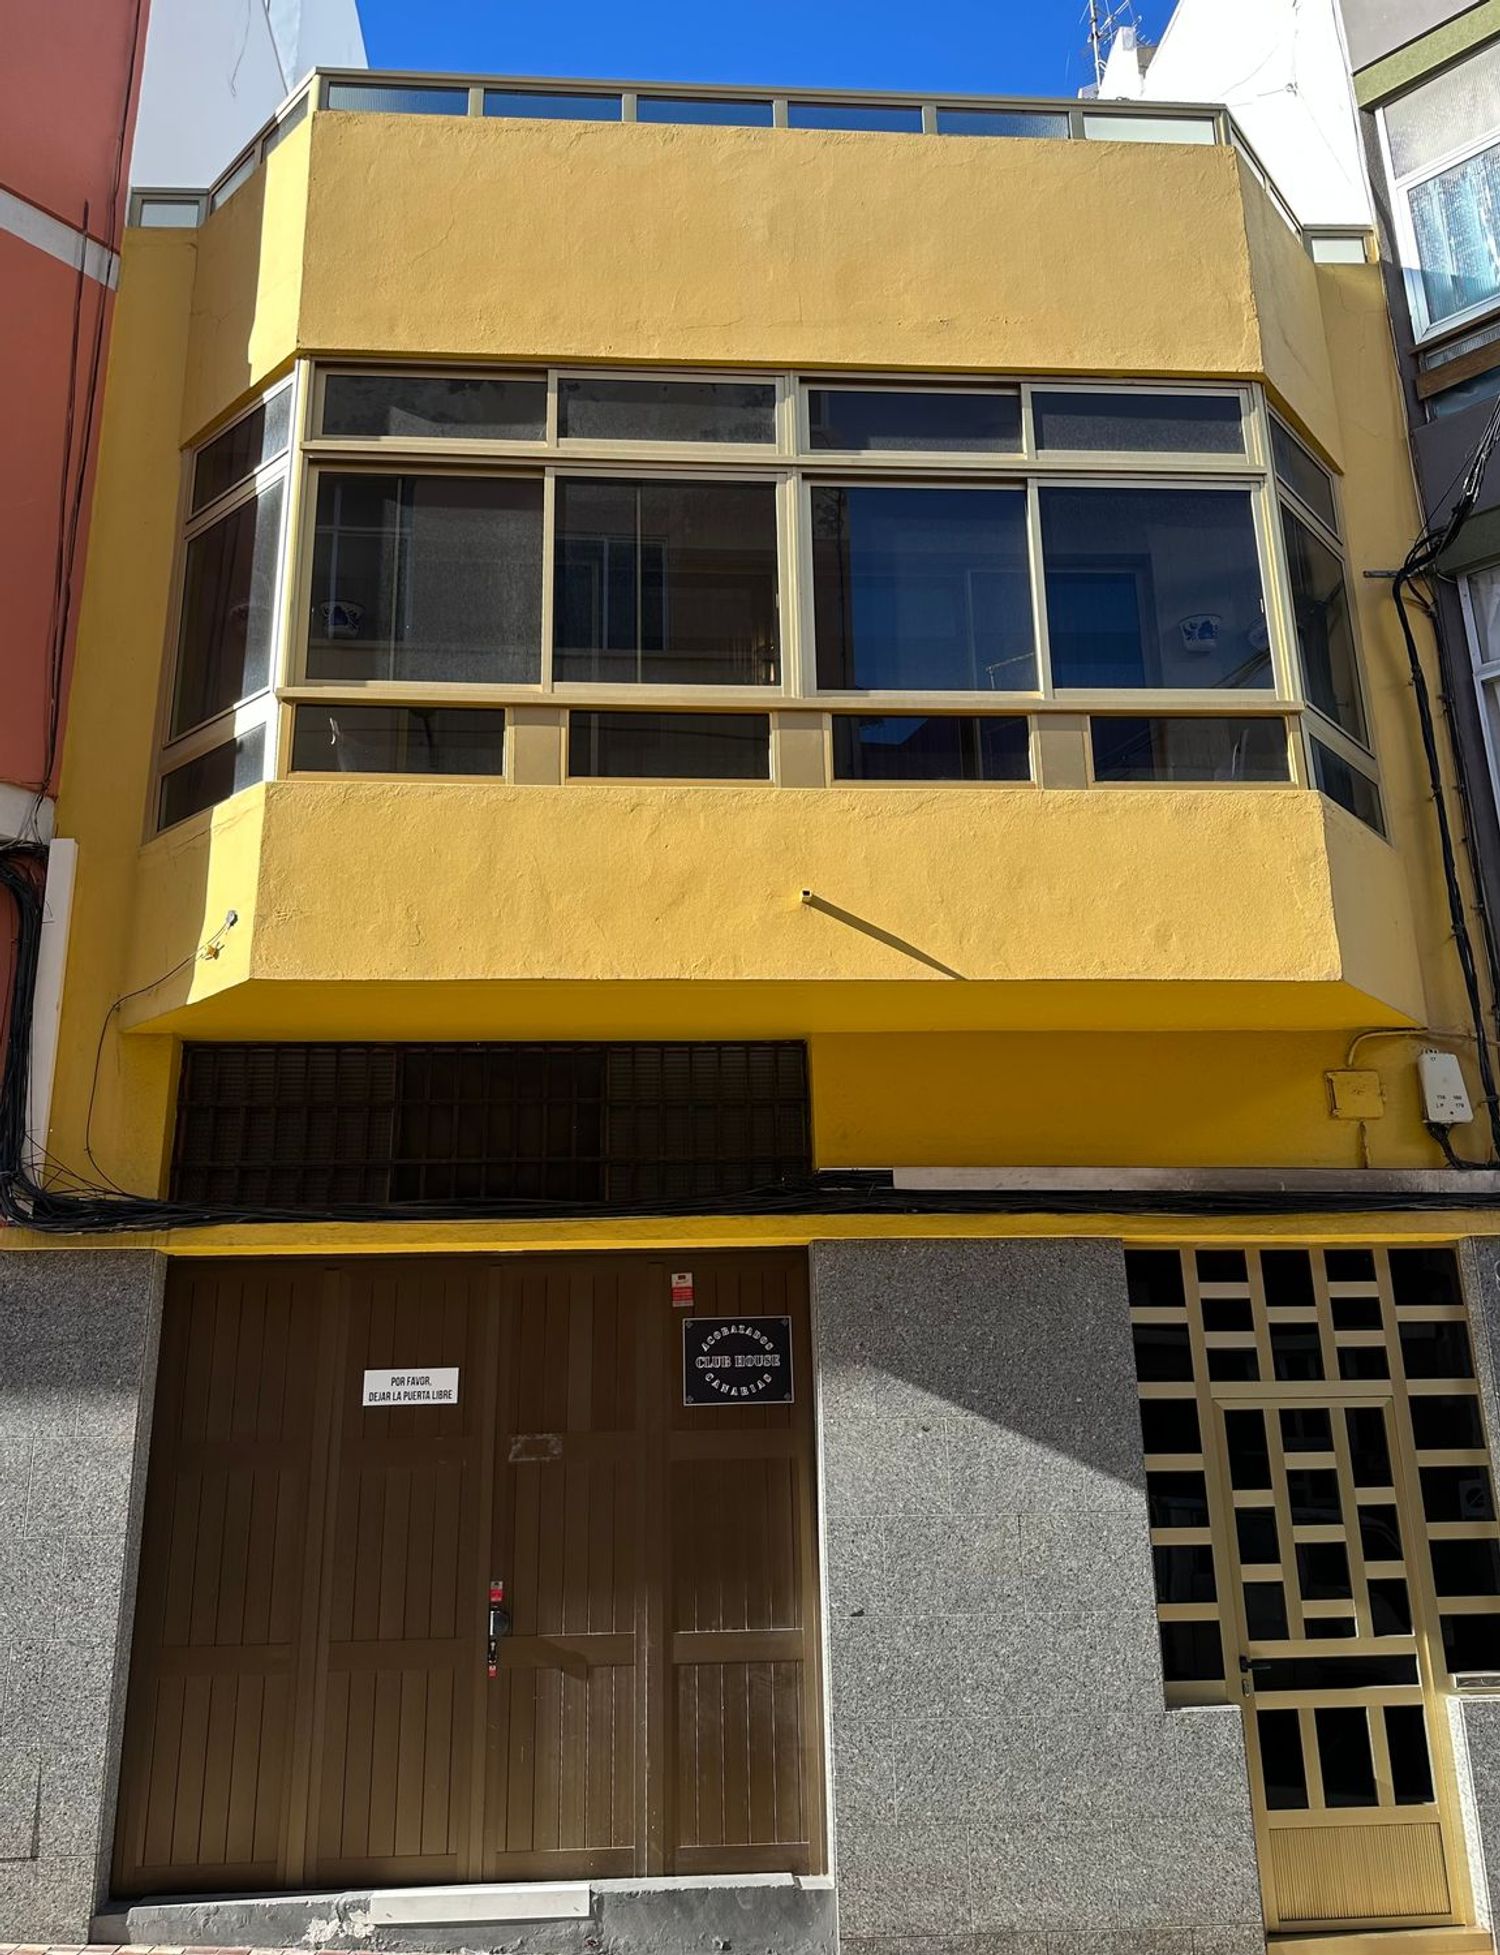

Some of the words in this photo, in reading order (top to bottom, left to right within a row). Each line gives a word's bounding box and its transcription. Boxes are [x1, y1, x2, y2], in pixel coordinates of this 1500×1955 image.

[695, 1355, 732, 1369] CLUB
[734, 1354, 781, 1368] HOUSE
[390, 1376, 405, 1387] POR
[704, 1372, 773, 1396] CANARIAS
[368, 1391, 391, 1402] DEJAR
[392, 1391, 402, 1401] LA
[403, 1390, 431, 1401] PUERTA
[432, 1389, 453, 1400] LIBRE
